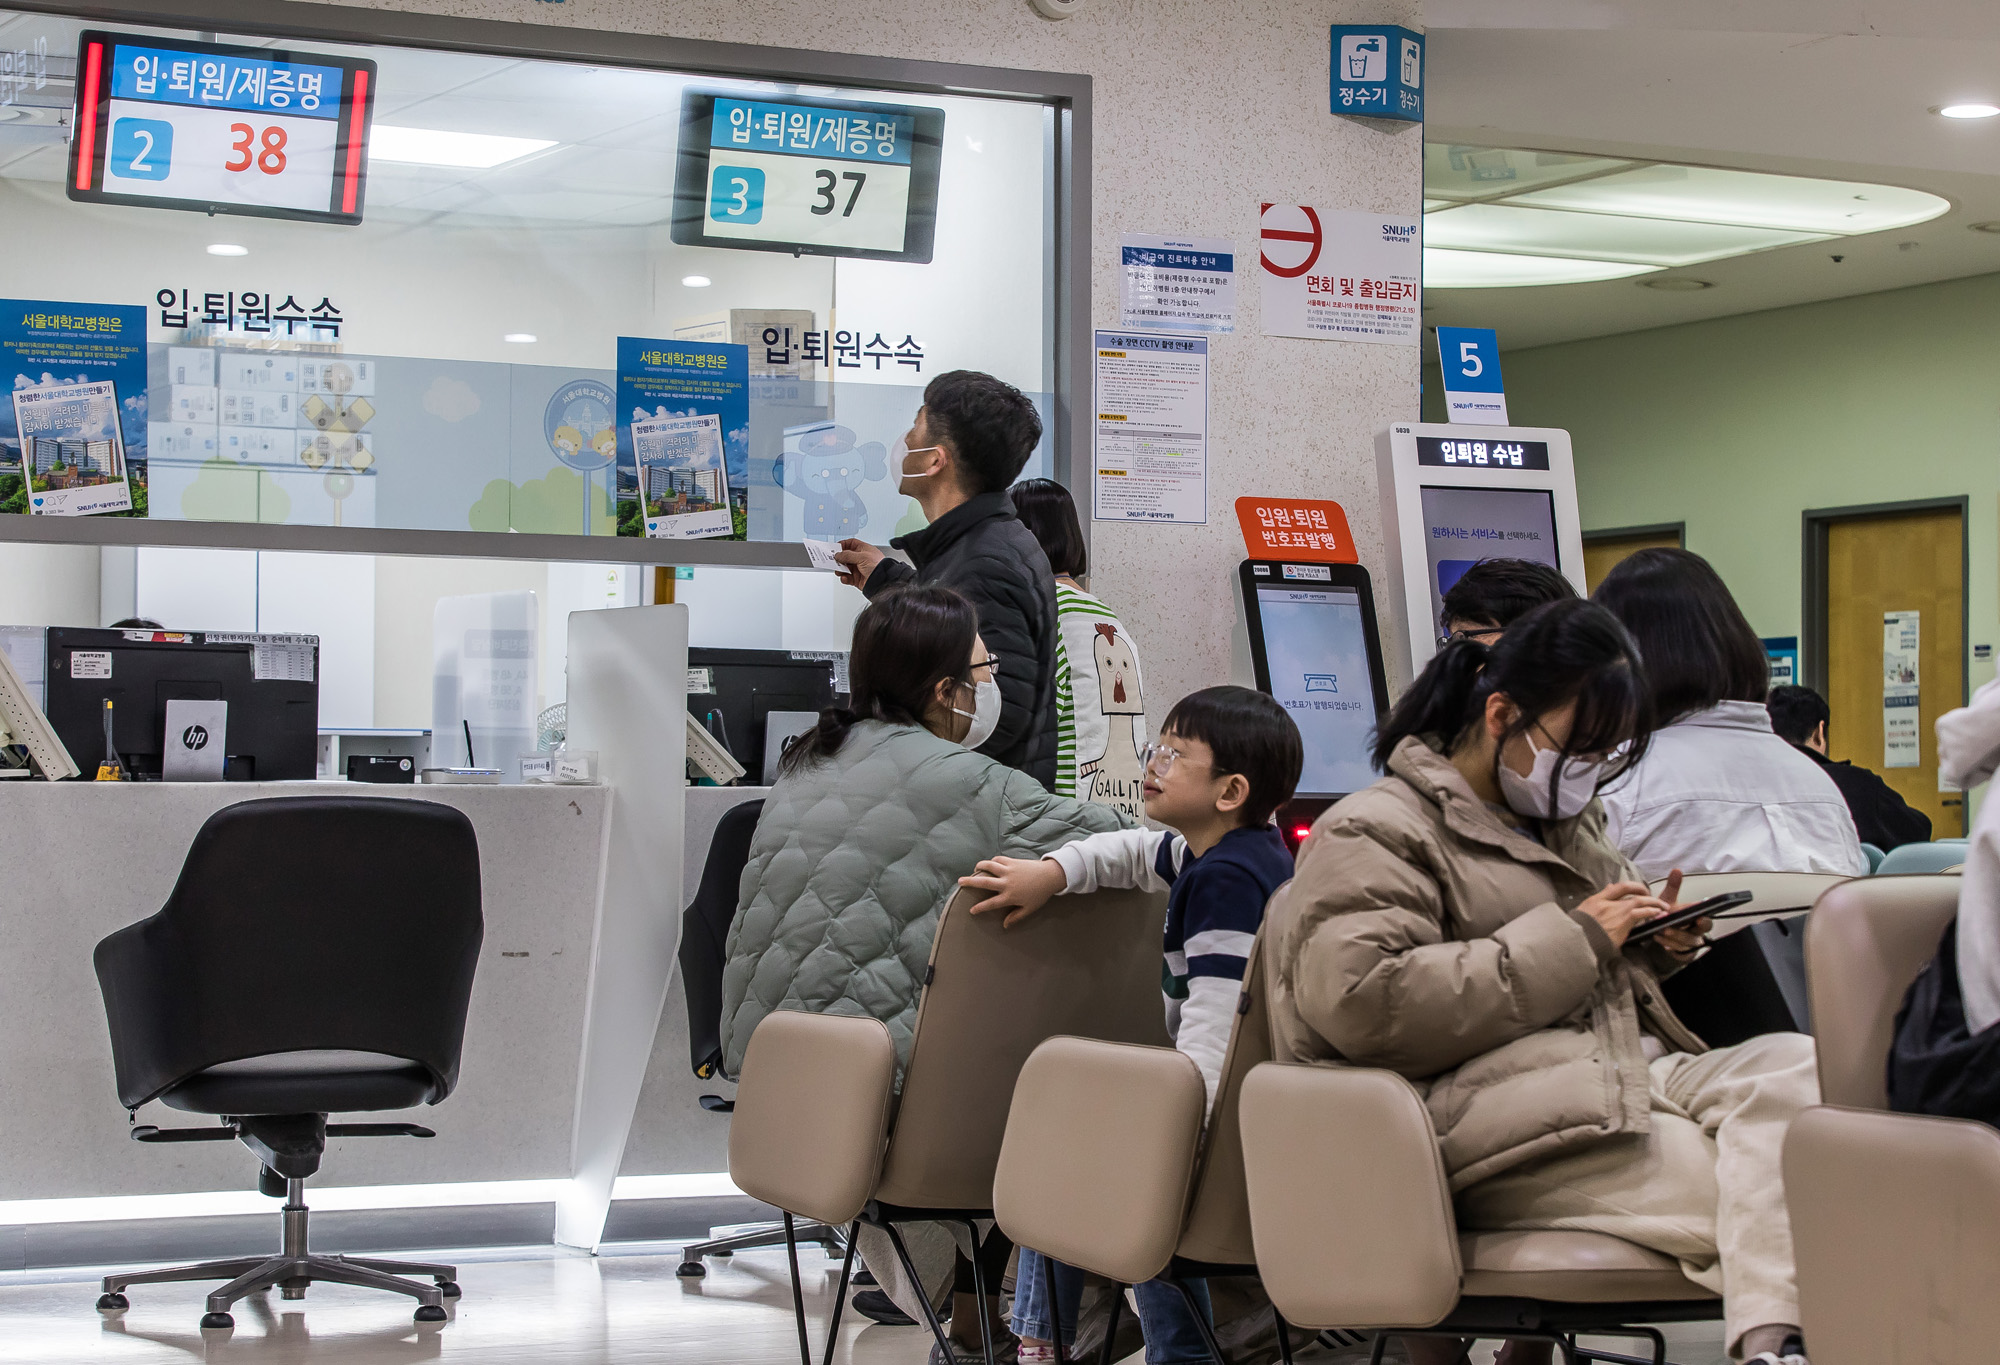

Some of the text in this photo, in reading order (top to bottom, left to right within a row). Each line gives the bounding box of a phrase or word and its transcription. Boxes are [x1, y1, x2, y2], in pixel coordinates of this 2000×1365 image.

[133, 56, 323, 111] 입·퇴원/제증명
[1339, 87, 1387, 106] 정수기
[1399, 89, 1420, 113] 정수기
[730, 108, 896, 157] 입·퇴원/제증명
[129, 130, 154, 172] 2
[225, 122, 288, 175] 38
[727, 177, 749, 216] 3
[810, 169, 866, 217] 37
[1382, 224, 1410, 236] SNUH
[1382, 235, 1410, 244] 서울대학교병원
[1167, 254, 1198, 266] 진료비용
[1201, 256, 1216, 267] 안내
[1190, 276, 1207, 284] 수수료
[1306, 275, 1417, 302] 면회 및 출입금지
[1157, 298, 1201, 307] 확인 가능합니다.
[1307, 299, 1331, 307] 서울특별시
[1332, 301, 1352, 309] 코로나19
[1354, 302, 1374, 311] 종합병원
[22, 313, 122, 332] 서울대학교병원은
[156, 288, 344, 338] 입·퇴원수속
[762, 327, 925, 373] 입·퇴원수속
[1126, 338, 1138, 347] 장면
[1139, 340, 1160, 349] CCTV
[1175, 342, 1195, 351] 안내문
[640, 351, 728, 369] 서울대학교병원은
[1459, 342, 1483, 378] 5
[562, 387, 611, 405] 서울대학교병원
[23, 407, 50, 421] 성원과
[54, 404, 80, 416] 격려의
[25, 421, 53, 433] 감사히
[640, 439, 664, 450] 성원과
[667, 436, 690, 447] 격려의
[641, 451, 665, 462] 감사히
[1441, 441, 1524, 466] 입퇴원 수납
[1256, 507, 1329, 530] 입원·퇴원
[1262, 530, 1336, 550] 번호표발행
[1432, 527, 1541, 541] 원하시는 서비스를 선택하세요.
[272, 636, 292, 644] 준비해
[295, 637, 316, 645] 주세요
[1284, 700, 1364, 711] 번호표가 발행되었습니다.
[184, 725, 207, 750] hp
